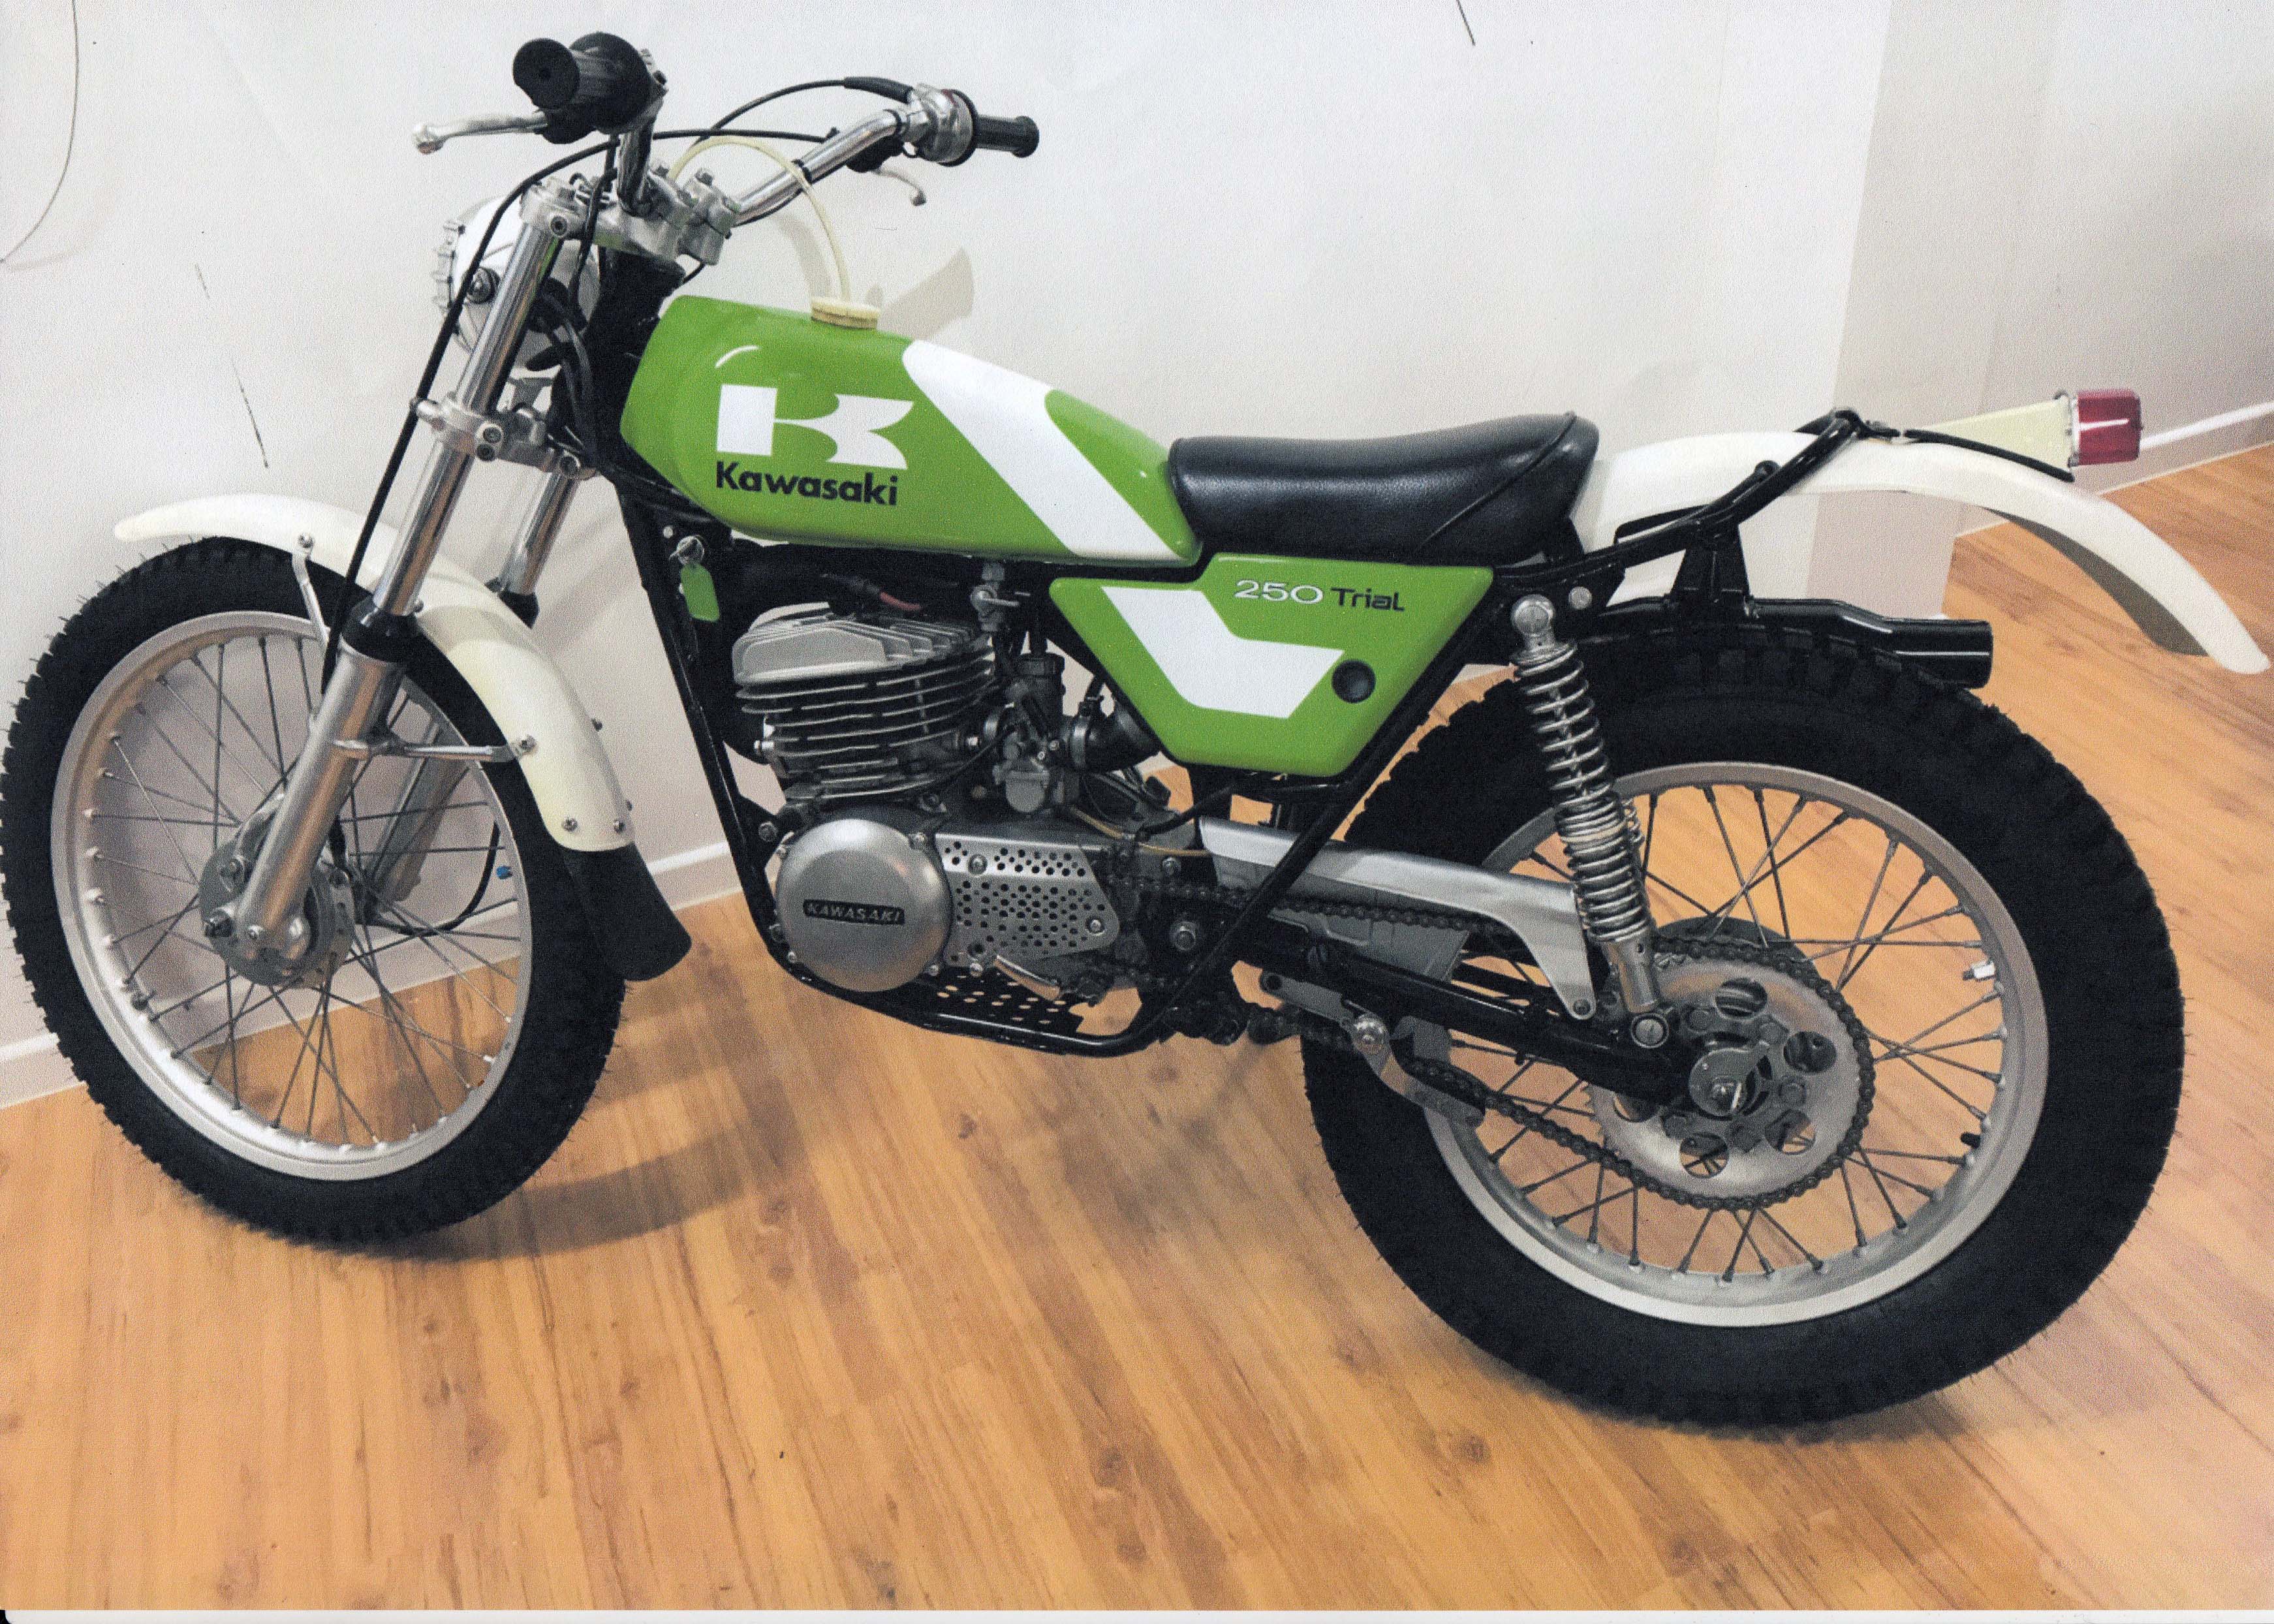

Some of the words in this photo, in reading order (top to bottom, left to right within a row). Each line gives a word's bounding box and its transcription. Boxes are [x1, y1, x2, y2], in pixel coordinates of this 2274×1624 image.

[716, 461, 898, 506] Kawasaki
[1235, 579, 1324, 604] 250
[807, 903, 901, 922] KAWASAKI
